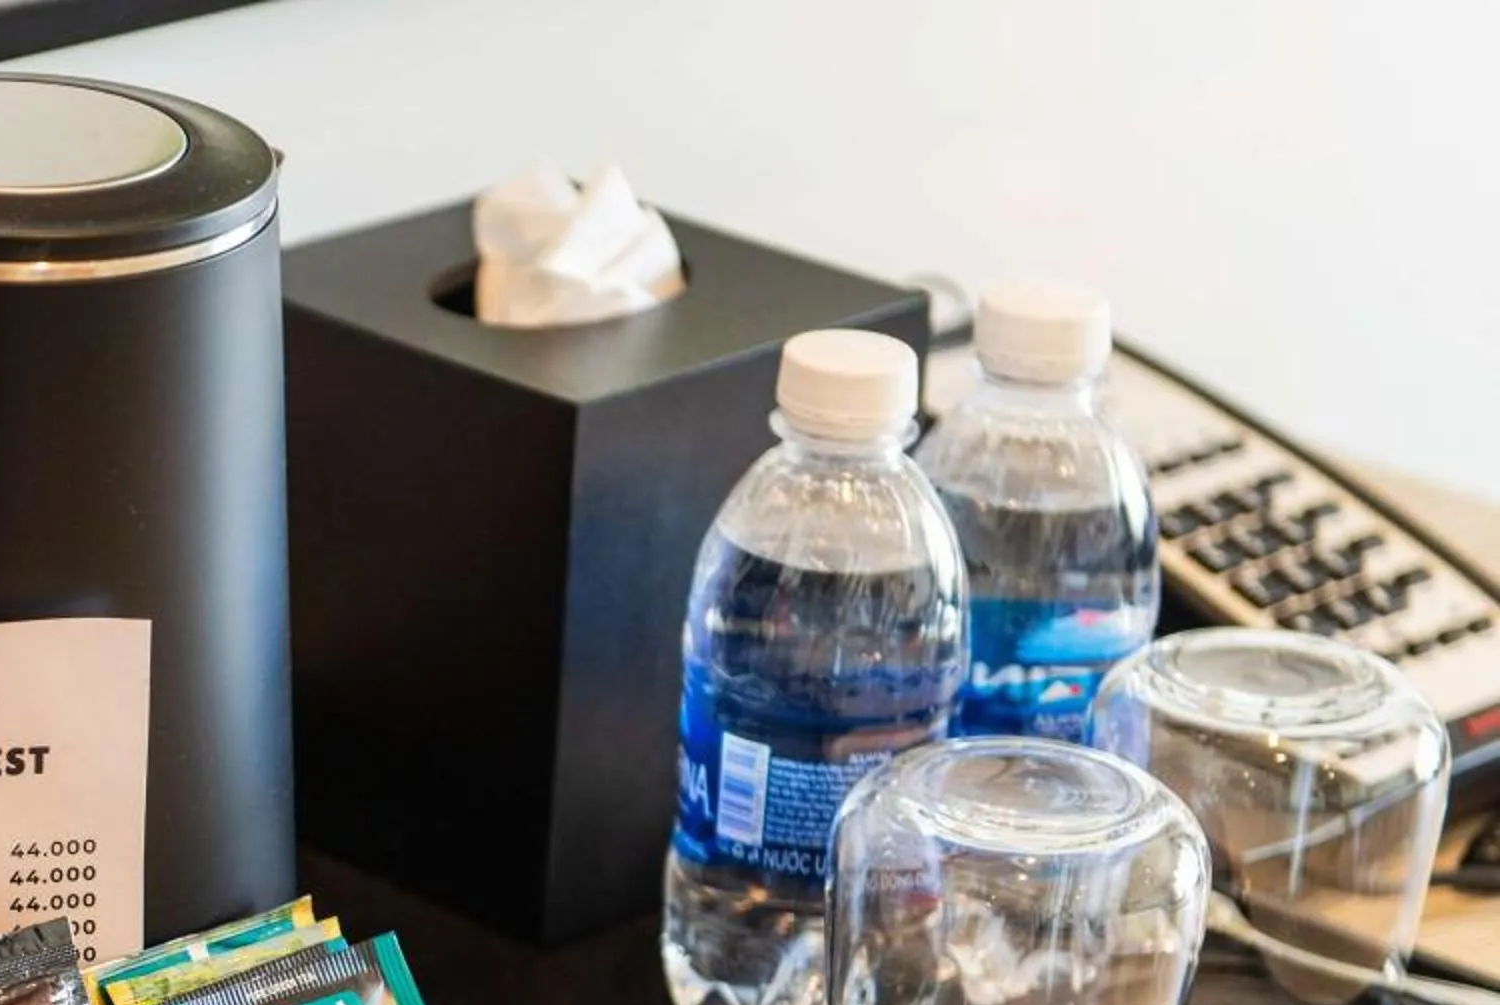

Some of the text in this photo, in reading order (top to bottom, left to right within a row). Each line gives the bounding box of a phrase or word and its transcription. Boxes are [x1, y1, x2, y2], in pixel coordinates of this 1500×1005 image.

[11, 839, 97, 859] 44.000
[9, 865, 97, 886] 44.000
[9, 893, 97, 913] 44.000
